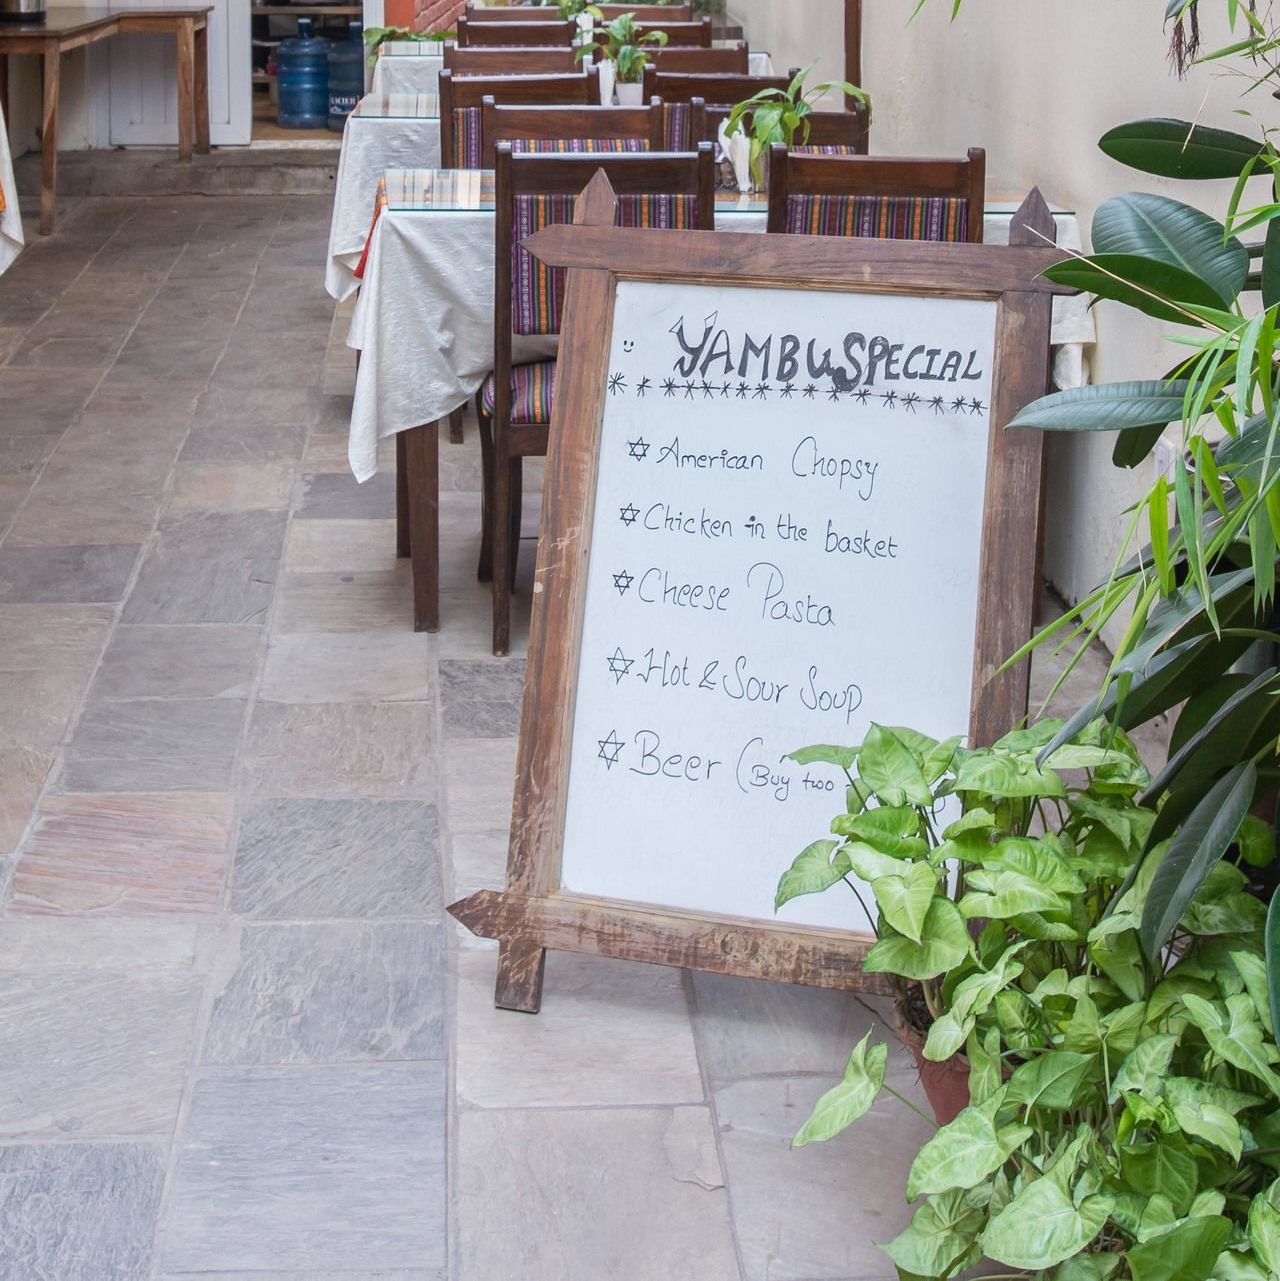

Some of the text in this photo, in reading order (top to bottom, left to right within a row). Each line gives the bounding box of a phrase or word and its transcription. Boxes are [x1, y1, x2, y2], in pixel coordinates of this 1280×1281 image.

[832, 331, 984, 393] SPECIAL
[656, 436, 878, 501] American Chopsy
[644, 503, 898, 559] Chicken in the basket
[639, 562, 836, 627] Cheese Pasta
[636, 647, 691, 688] Hot
[800, 665, 863, 725] Soup
[629, 730, 722, 788] Beer
[802, 771, 835, 792] two
